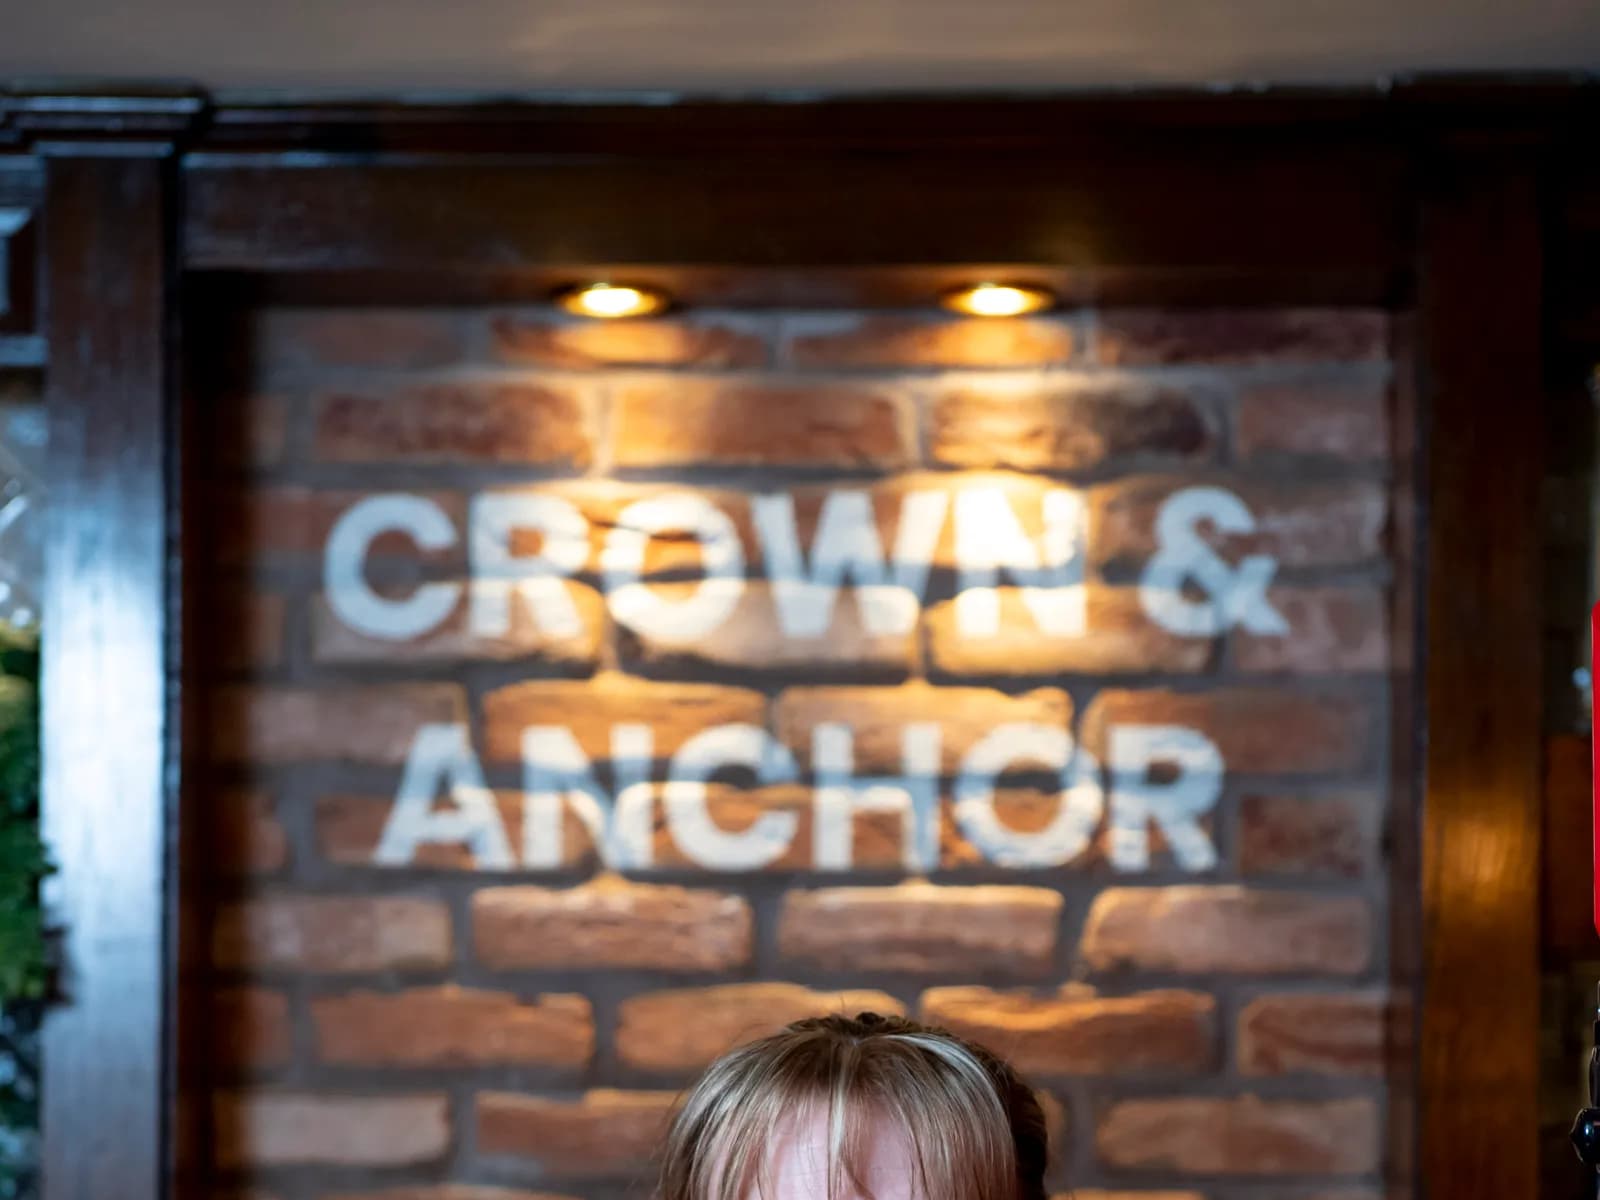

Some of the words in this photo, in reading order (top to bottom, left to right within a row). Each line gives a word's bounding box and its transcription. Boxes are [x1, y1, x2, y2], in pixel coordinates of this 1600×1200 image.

[322, 490, 1089, 642] CROWN
[1139, 486, 1291, 639] &
[373, 722, 1225, 872] ANCHOR
